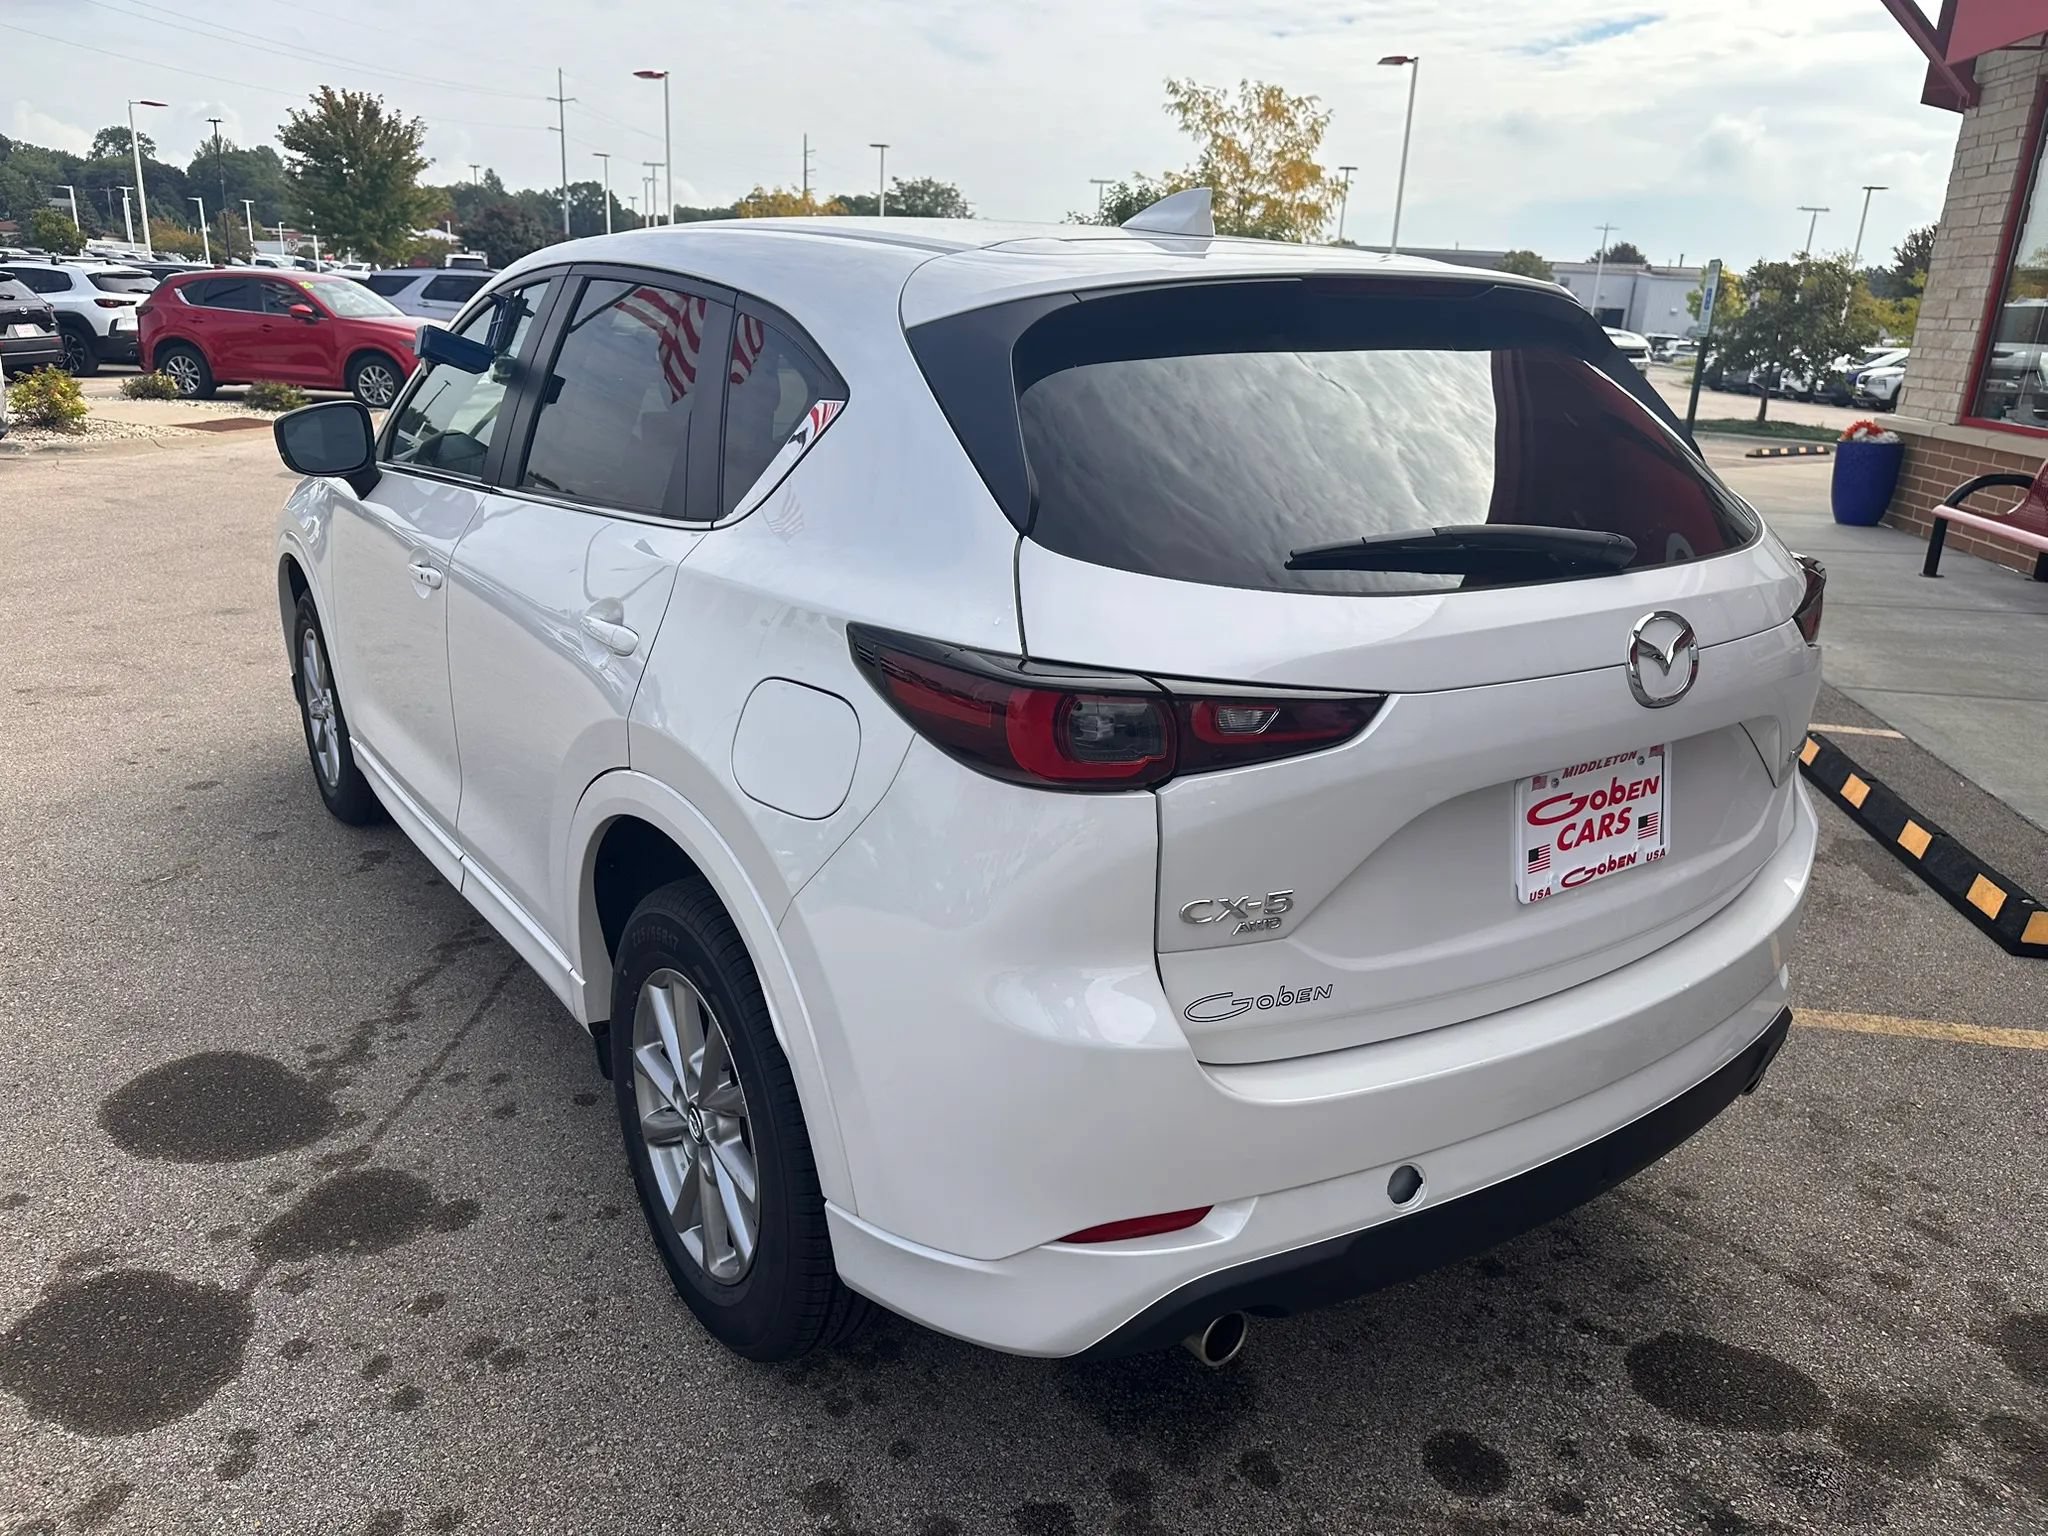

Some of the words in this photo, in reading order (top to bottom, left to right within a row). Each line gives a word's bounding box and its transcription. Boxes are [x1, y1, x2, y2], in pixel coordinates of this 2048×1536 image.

[1562, 751, 1638, 779] MIDDLETON
[1557, 807, 1632, 852] CARS
[1646, 848, 1666, 862] USA
[1529, 887, 1551, 902] USA
[1179, 889, 1294, 924] CX-5
[1231, 917, 1282, 936] AWD
